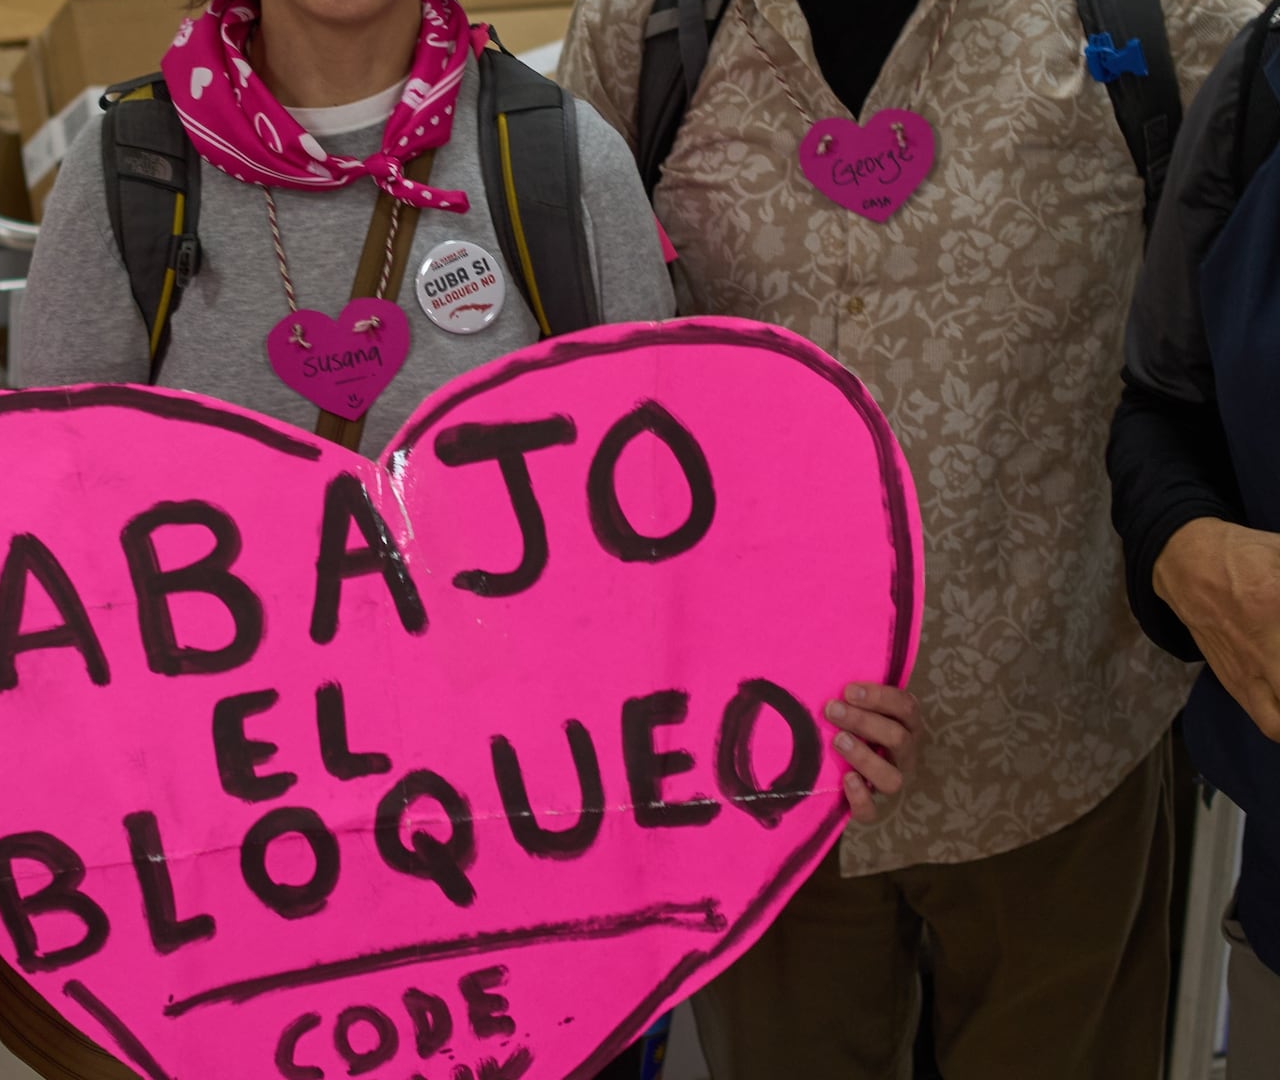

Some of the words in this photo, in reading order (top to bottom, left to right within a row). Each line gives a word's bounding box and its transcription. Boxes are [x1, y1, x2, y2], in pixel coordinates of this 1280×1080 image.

[831, 146, 914, 187] George
[424, 267, 470, 297] CUBA
[472, 257, 491, 276] SI
[431, 281, 480, 310] BLOQUEO
[480, 273, 496, 288] NO
[211, 679, 394, 805] EL
[275, 964, 517, 1080] CODE
